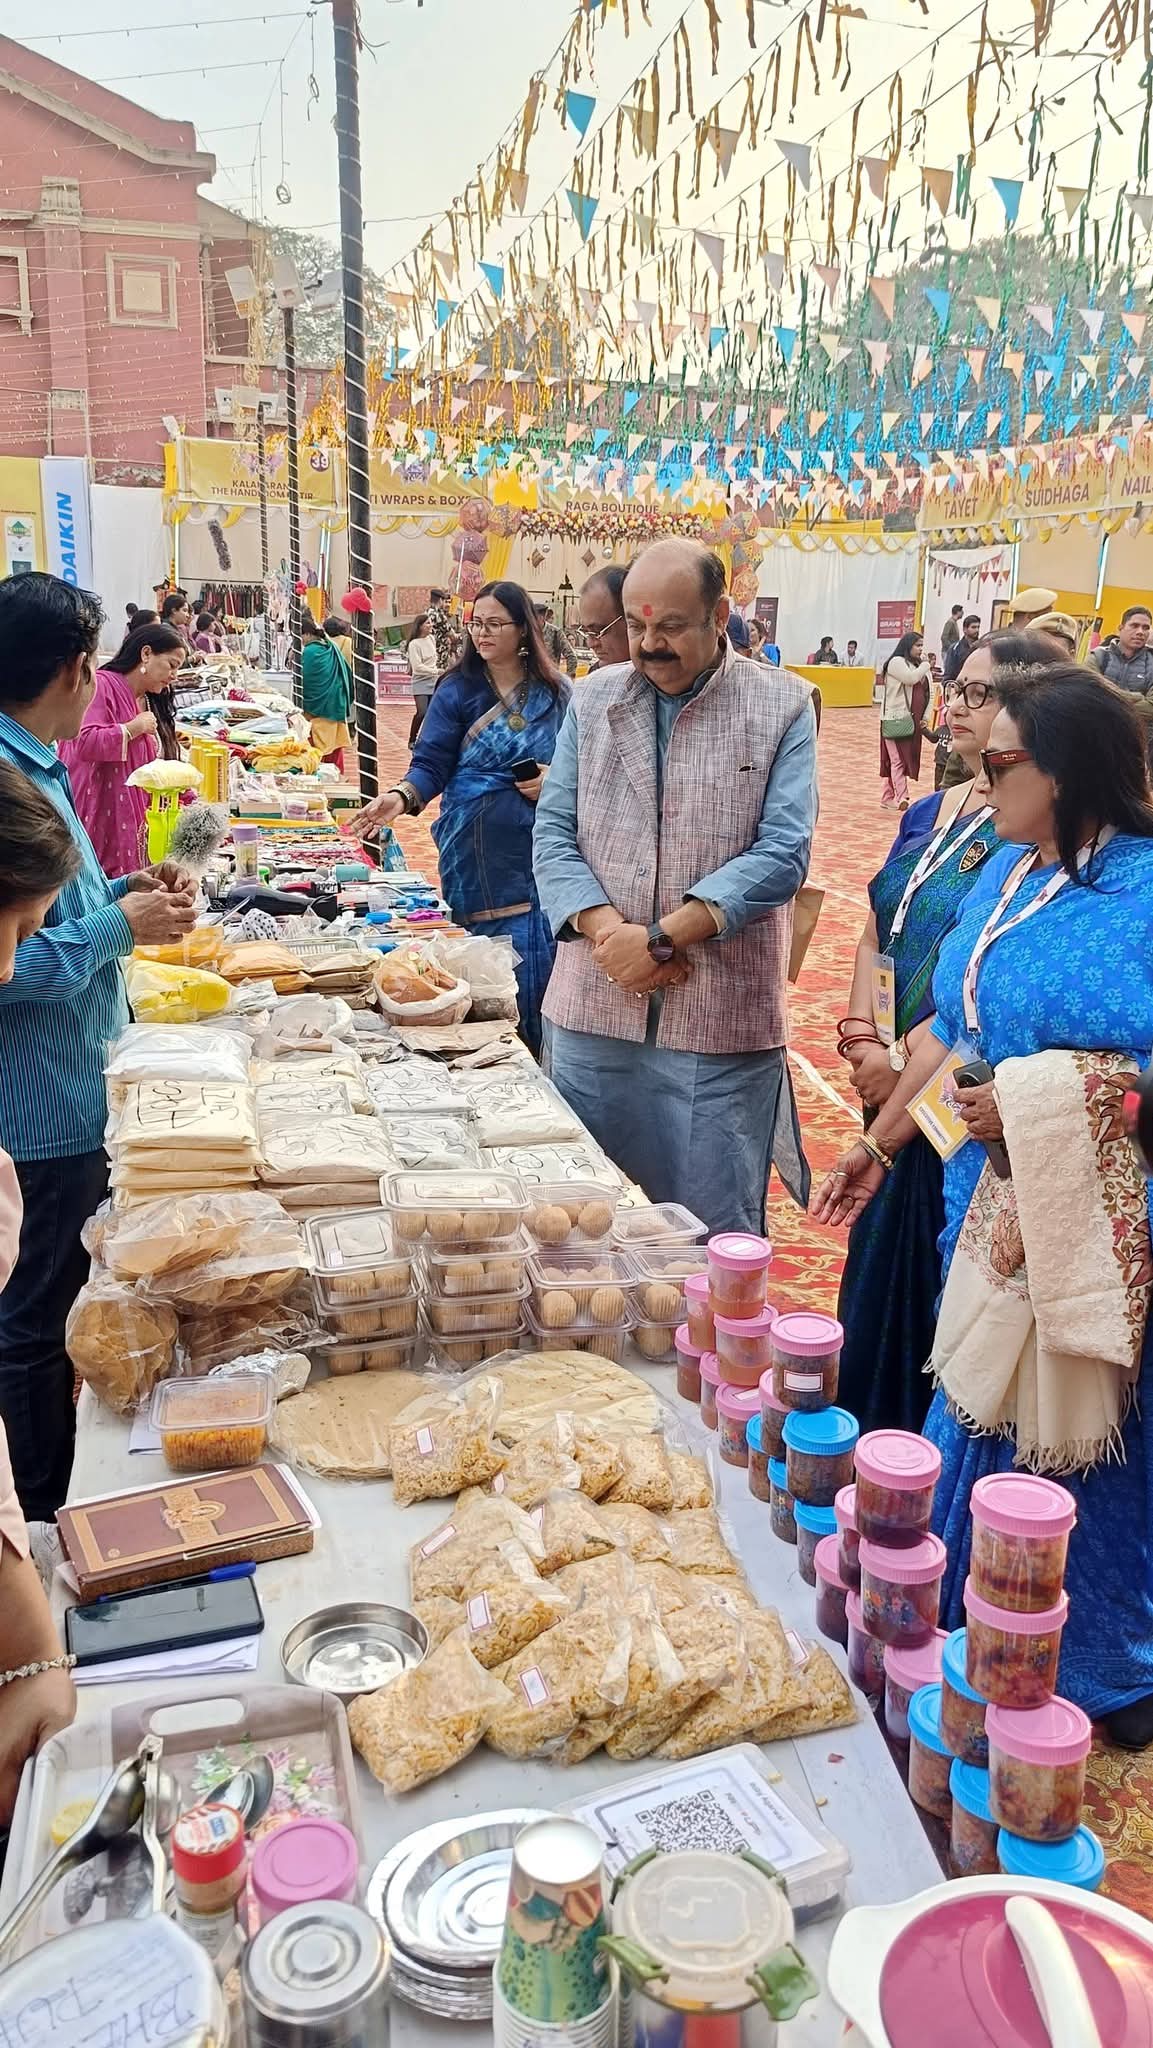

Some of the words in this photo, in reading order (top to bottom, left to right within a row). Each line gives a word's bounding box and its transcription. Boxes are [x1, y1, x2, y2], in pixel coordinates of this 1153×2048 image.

[311, 455, 329, 468] 39
[211, 487, 228, 496] THE
[230, 488, 286, 498] HANDOM
[1121, 476, 1153, 496] NAIL
[380, 495, 425, 505] WRAPS
[427, 496, 437, 505] &
[1025, 482, 1089, 508] SUIDHAGA
[566, 501, 599, 512] RAGA
[601, 503, 660, 514] BOUTIQUE
[944, 498, 979, 520] TAYET
[56, 492, 78, 587] DAIKIN
